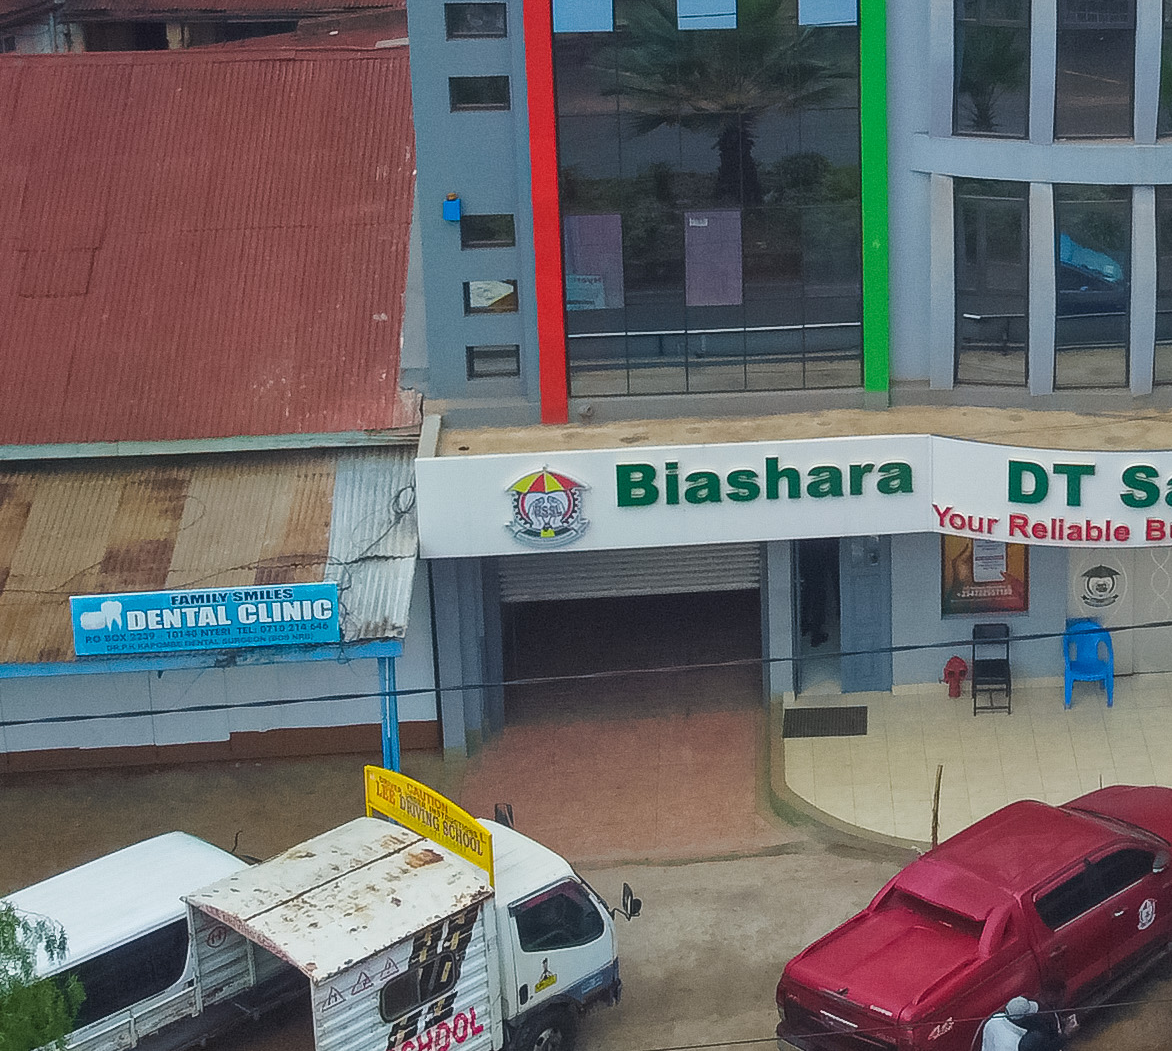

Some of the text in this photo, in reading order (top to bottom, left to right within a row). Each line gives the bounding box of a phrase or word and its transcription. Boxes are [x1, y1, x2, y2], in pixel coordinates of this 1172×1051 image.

[615, 455, 915, 508] Biashara
[1007, 458, 1096, 507] DT
[932, 502, 998, 536] Your
[1008, 512, 1130, 542] Reliable
[171, 588, 294, 606] FAMILY SMILES
[127, 599, 333, 631] DENTAL CLINIC
[104, 633, 127, 642] BOX
[200, 629, 231, 638] NYERI
[222, 636, 265, 645] SURGEON
[406, 783, 449, 814] CAUTION
[376, 780, 484, 856] LEE DRIVING SCHOOL
